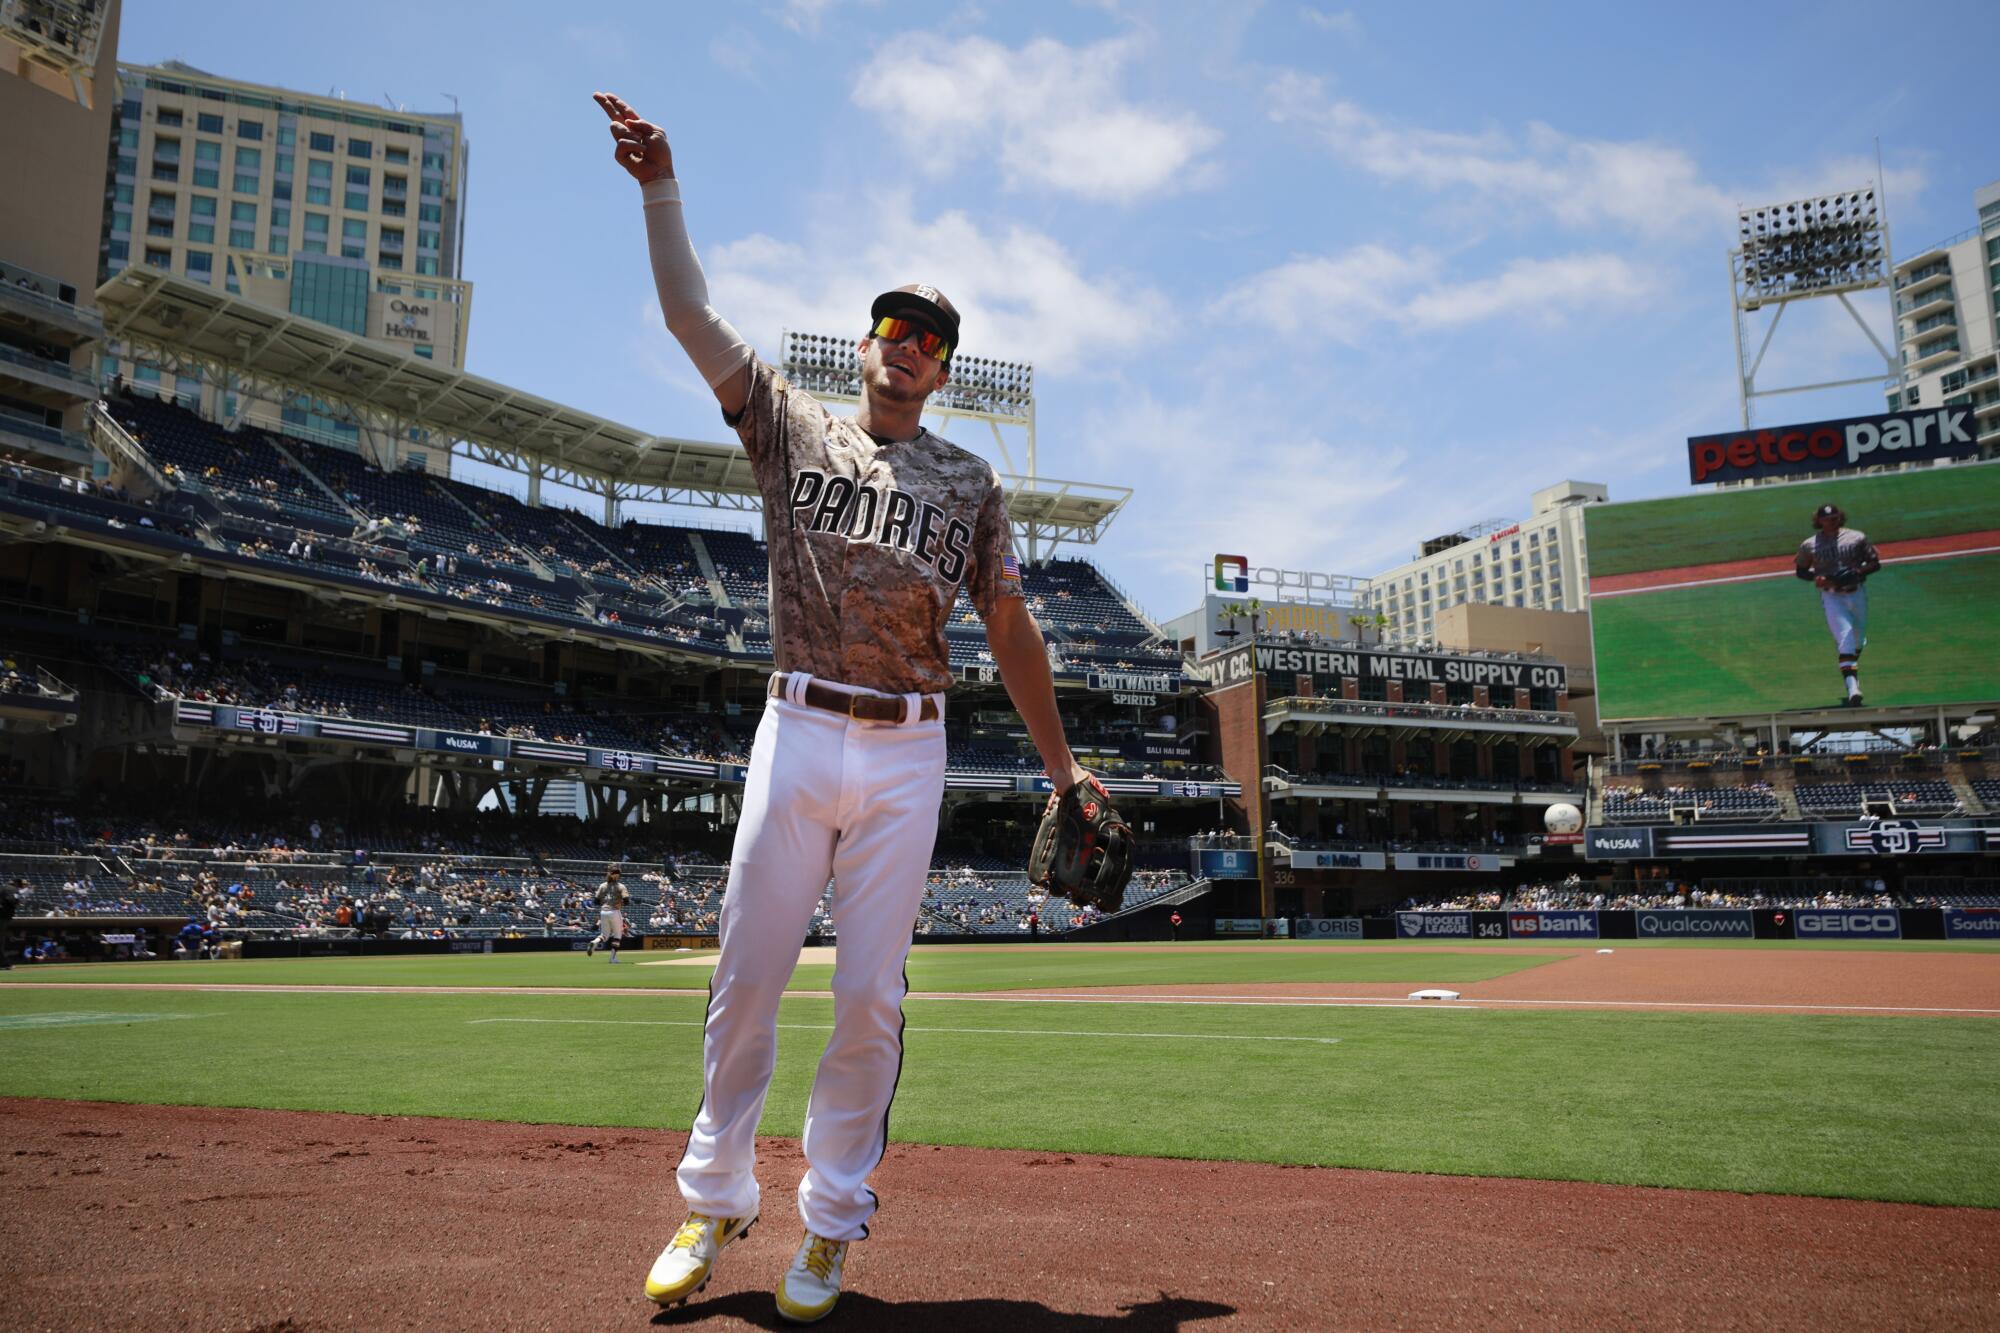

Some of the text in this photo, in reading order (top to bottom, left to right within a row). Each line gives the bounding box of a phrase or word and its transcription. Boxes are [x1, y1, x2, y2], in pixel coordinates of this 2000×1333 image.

[791, 469, 972, 585] PADRES
[1267, 606, 1342, 639] PADRES
[1230, 652, 1253, 680] CO.
[1255, 647, 1565, 688] WESTERN METAL SUPPLY CO.
[1099, 673, 1170, 693] CUTWATER
[1112, 693, 1157, 706] SPIRITS
[1146, 746, 1162, 754] BALI
[1274, 870, 1295, 885] 336
[1318, 920, 1360, 933] ORIS
[1425, 916, 1469, 925] ROCKET
[1641, 915, 1749, 934] Qualcomm
[1799, 914, 1897, 932] GEICO
[1425, 924, 1469, 934] LEAGUE
[1478, 922, 1502, 937] 343
